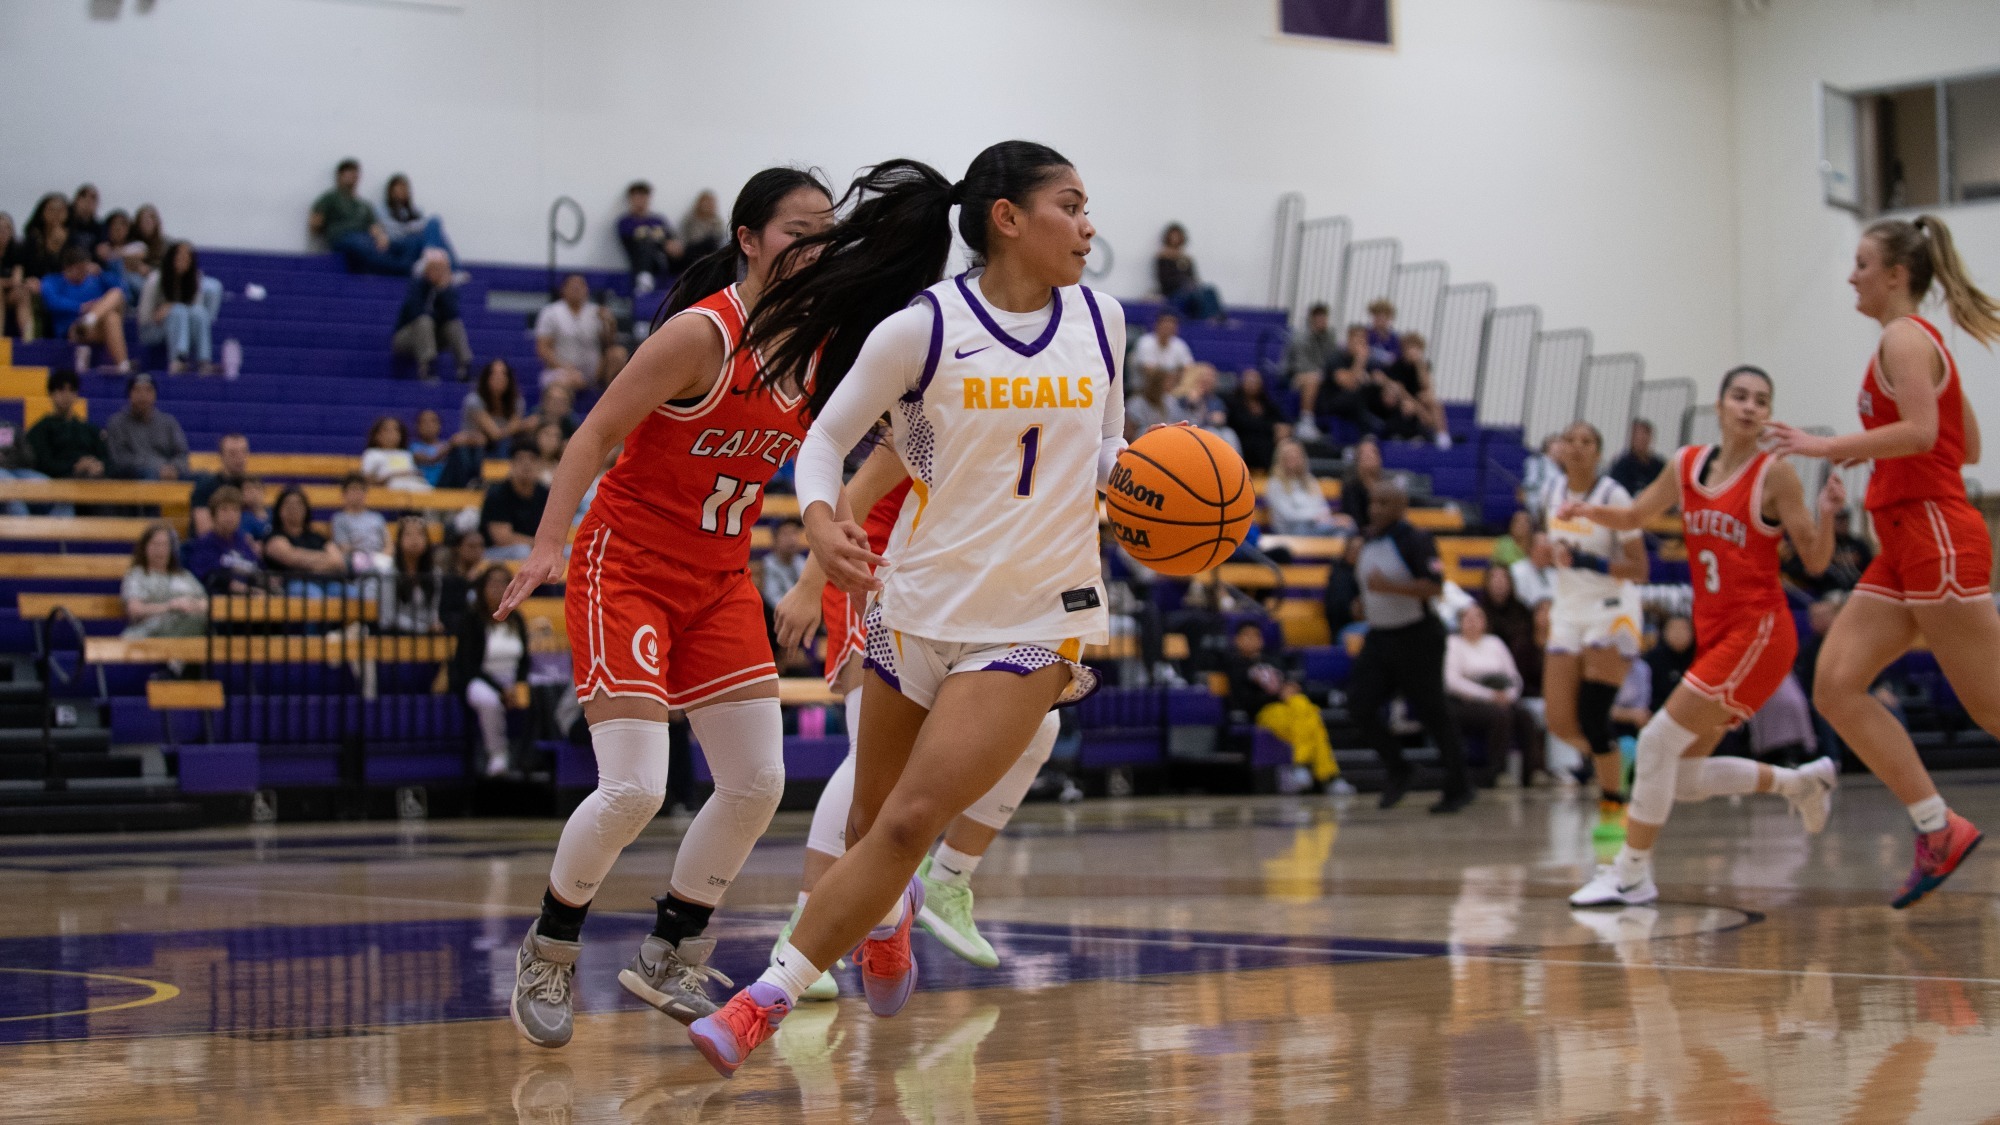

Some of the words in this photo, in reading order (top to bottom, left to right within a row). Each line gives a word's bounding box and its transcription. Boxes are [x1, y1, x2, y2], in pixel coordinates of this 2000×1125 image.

[962, 376, 1093, 409] REGALS
[1014, 423, 1043, 499] 1
[699, 472, 762, 537] 11
[1107, 515, 1151, 549] CAA
[1698, 549, 1721, 594] 3
